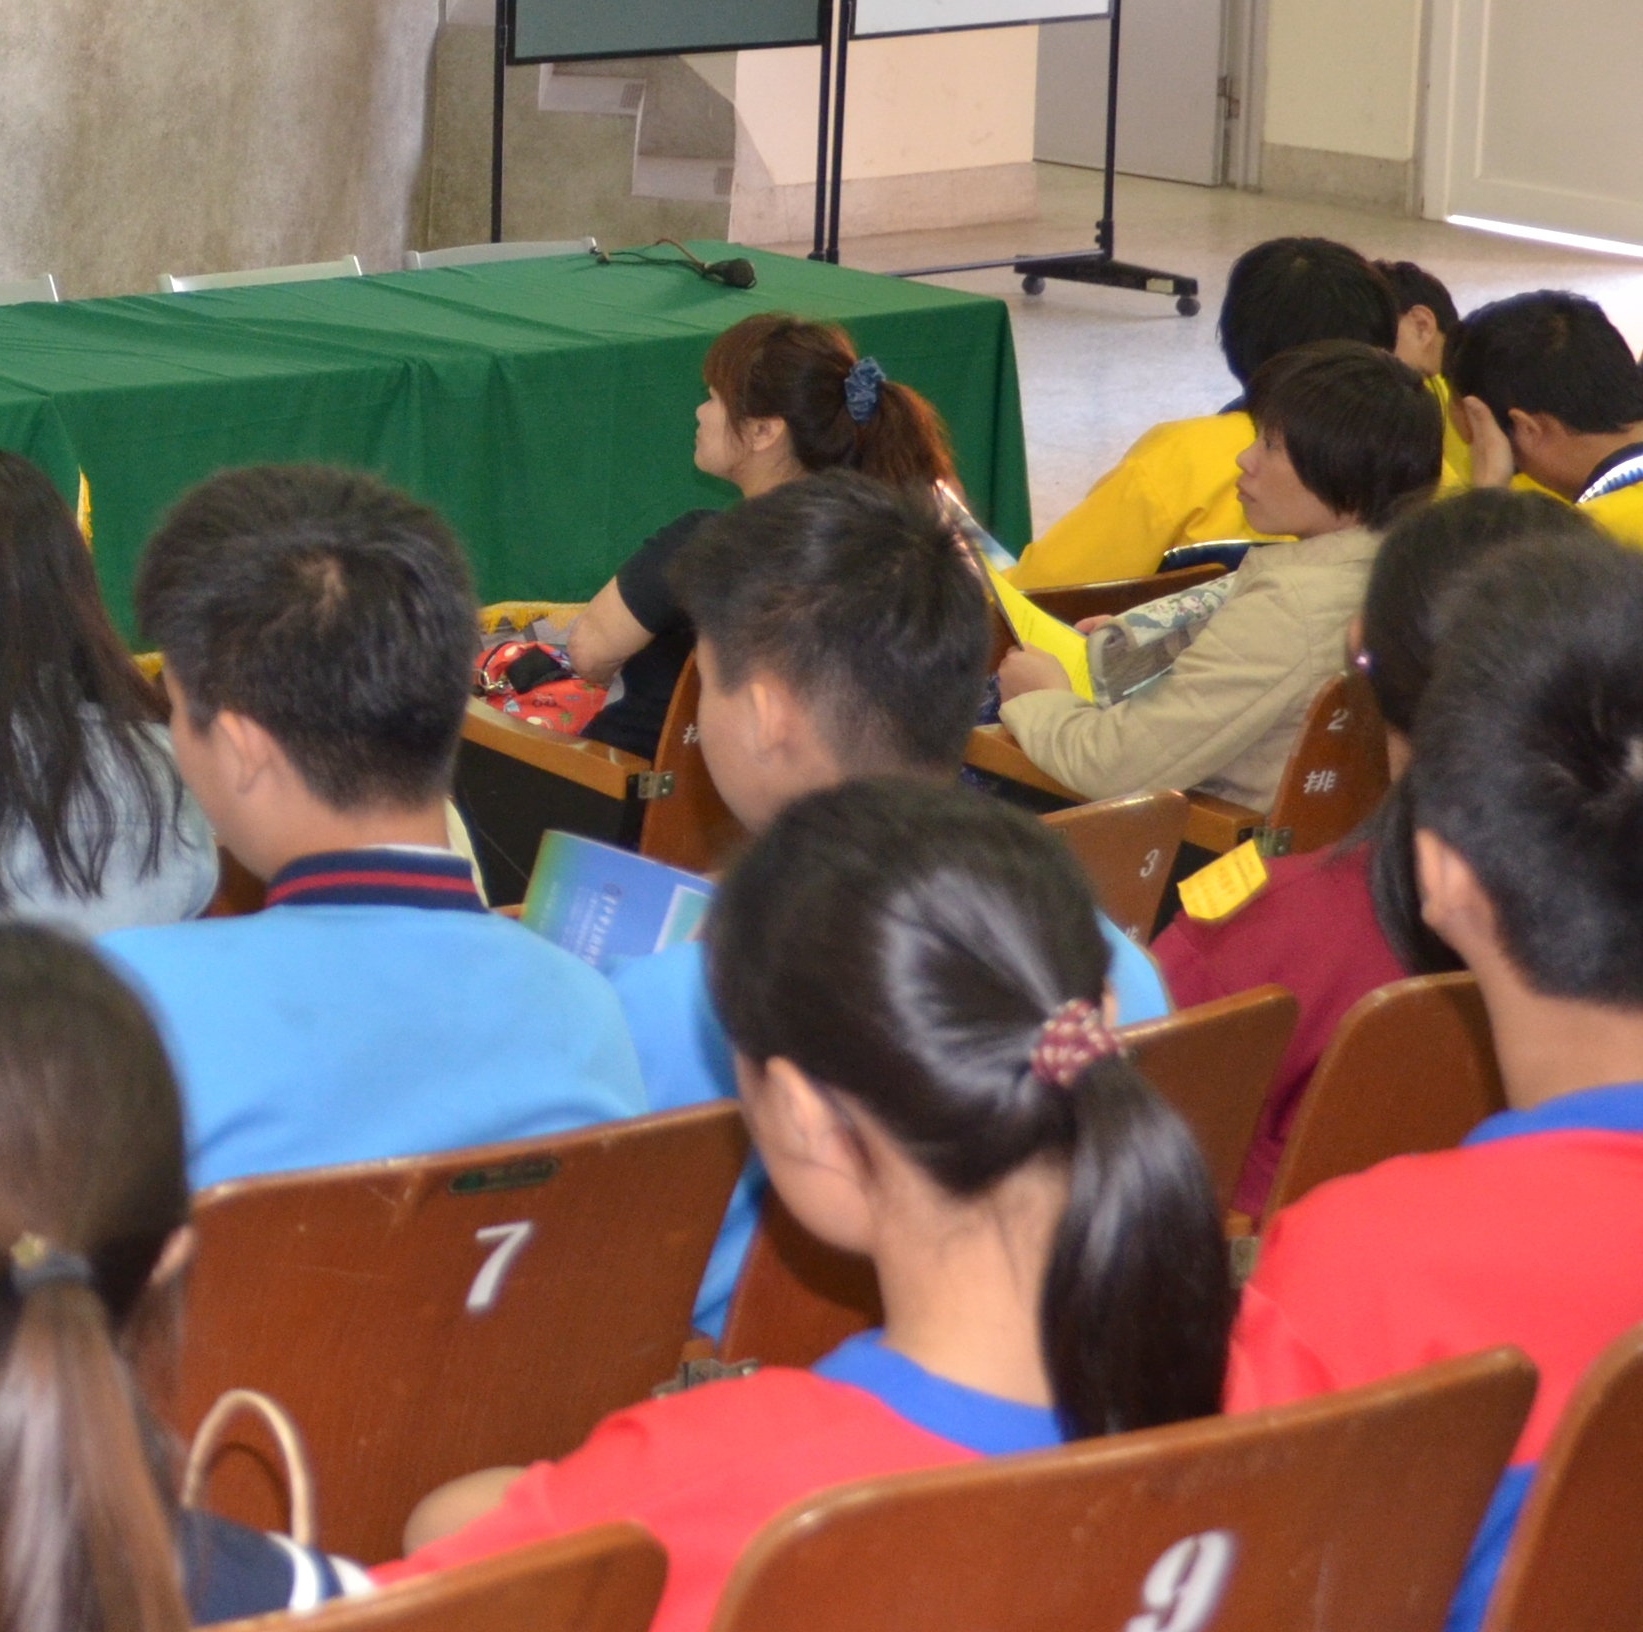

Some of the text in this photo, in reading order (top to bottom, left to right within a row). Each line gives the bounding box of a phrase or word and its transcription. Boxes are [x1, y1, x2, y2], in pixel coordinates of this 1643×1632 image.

[1326, 708, 1350, 730] 2
[1302, 770, 1337, 795] 排
[1139, 848, 1160, 878] 3
[466, 1219, 535, 1314] 7
[1124, 1527, 1234, 1632] 9
